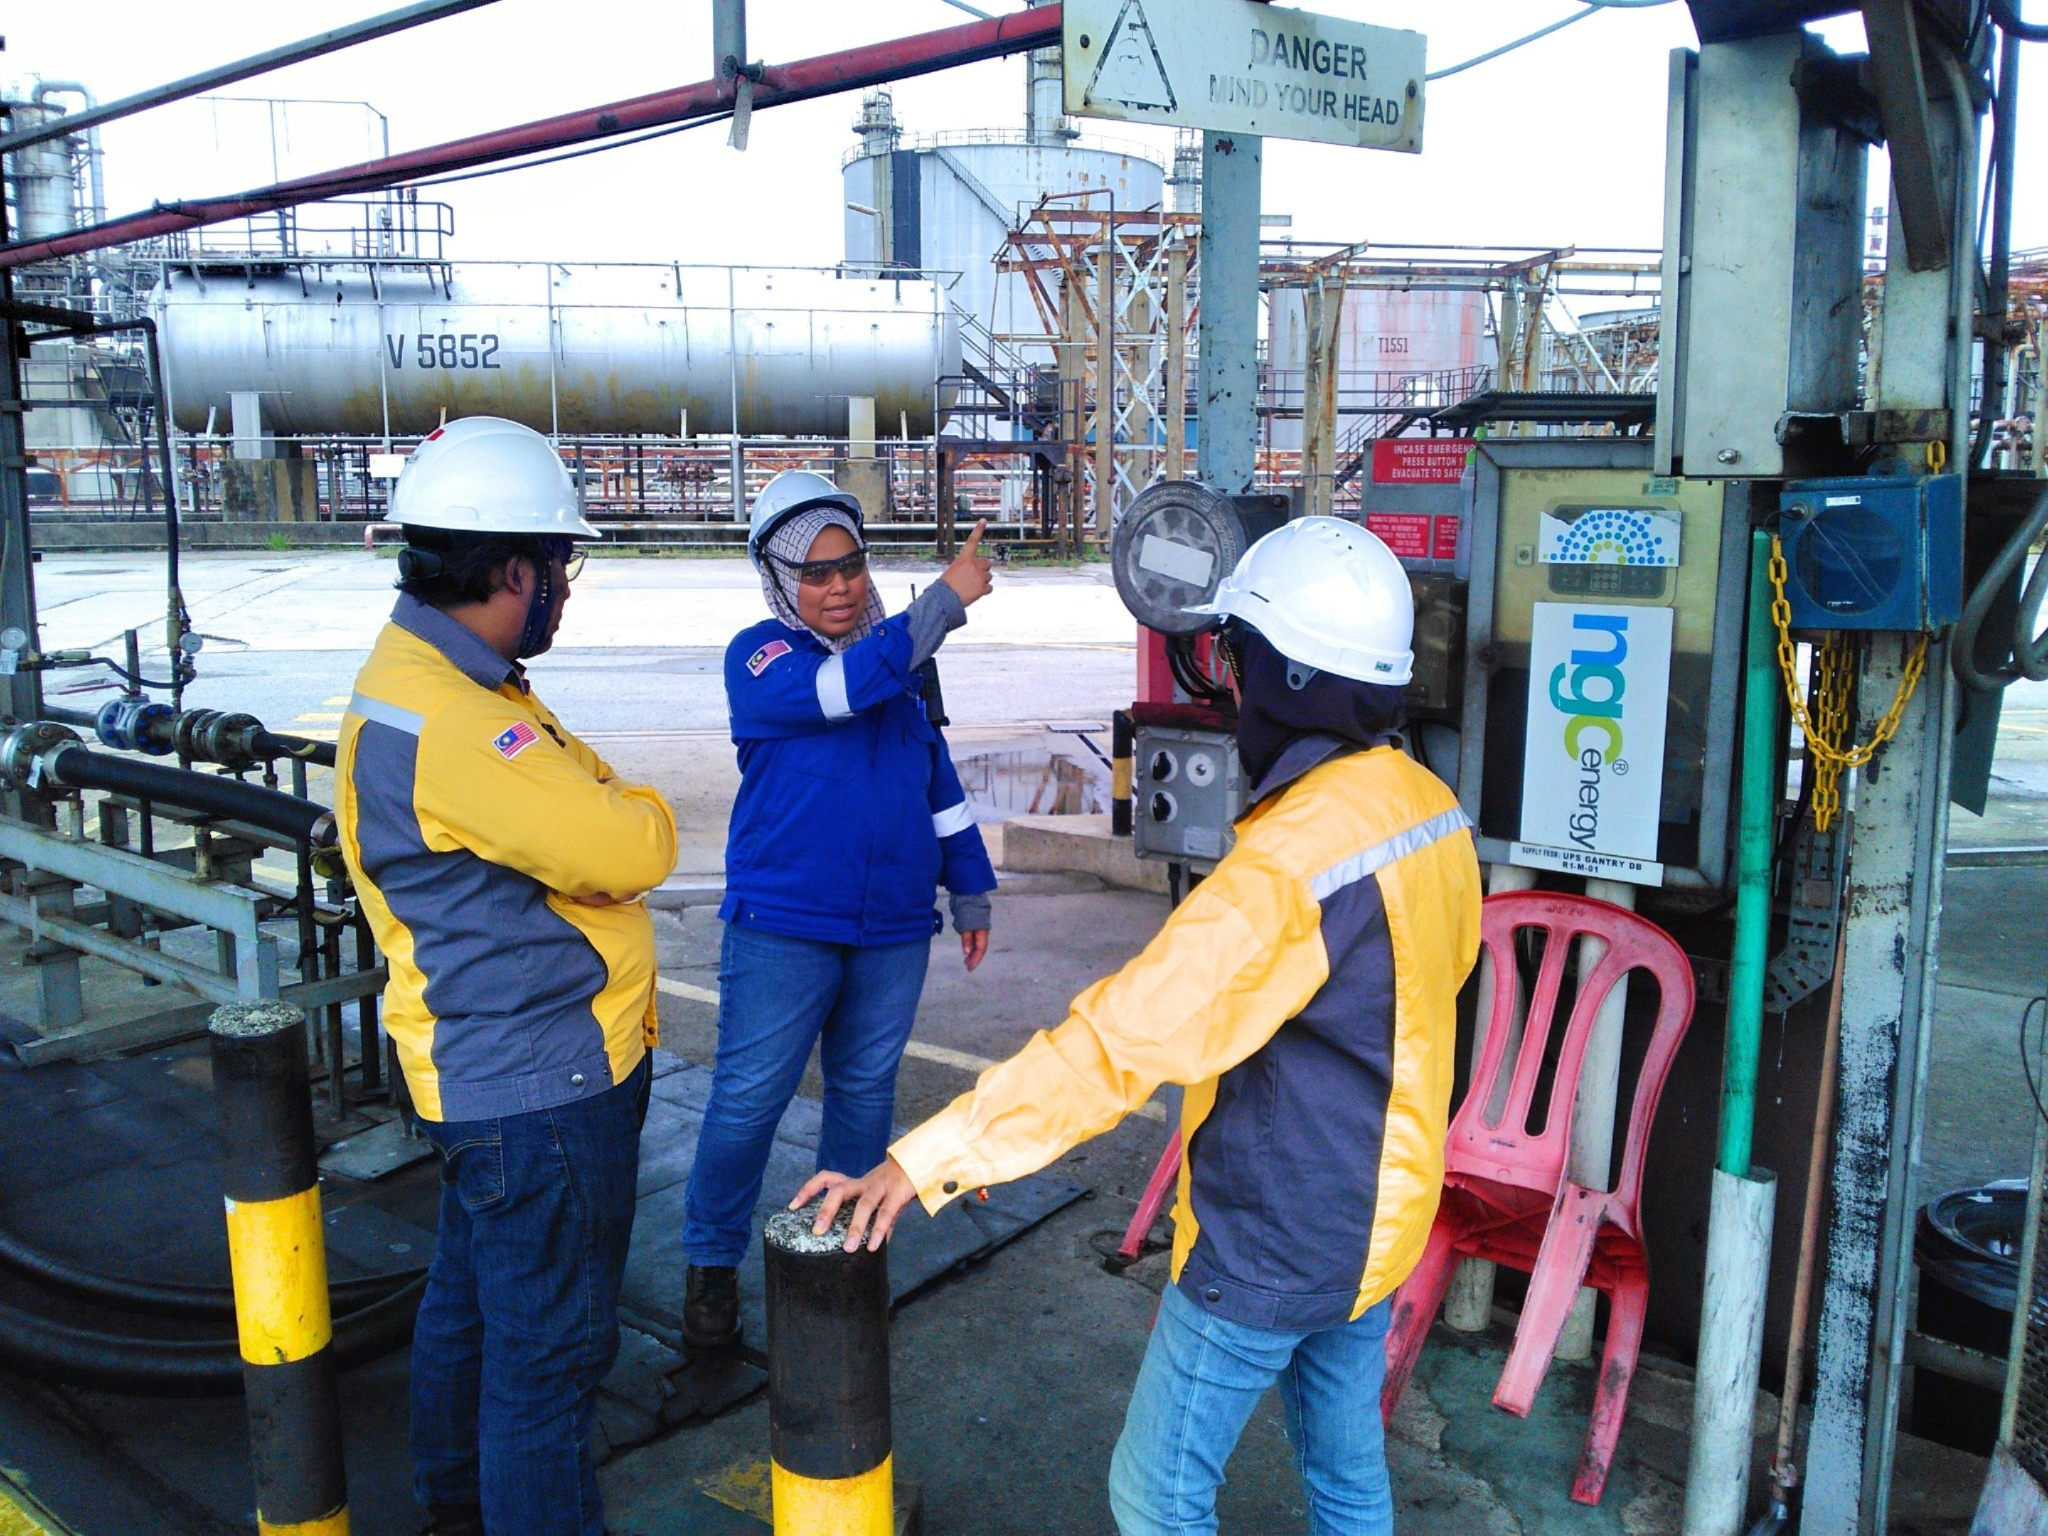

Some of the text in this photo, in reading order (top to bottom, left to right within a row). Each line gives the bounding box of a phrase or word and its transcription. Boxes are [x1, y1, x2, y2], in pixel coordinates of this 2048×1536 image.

[1251, 28, 1367, 80] DANGER
[1209, 74, 1399, 126] MIND YOUR HEAD
[386, 334, 500, 368] V 5852
[1378, 337, 1409, 353] T1551
[1394, 444, 1425, 454] INCASE
[1402, 456, 1425, 466] PRESS
[1427, 456, 1457, 466] BUTTON
[1392, 468, 1430, 478] EVACUATE
[1433, 468, 1442, 478] TO
[1550, 614, 1629, 851] ngc energy
[1522, 846, 1542, 856] SUPPLY
[1563, 852, 1581, 862] UPS
[1585, 856, 1625, 868] GANTRY
[1629, 862, 1642, 871] DB
[1563, 861, 1599, 873] R1-M-01
